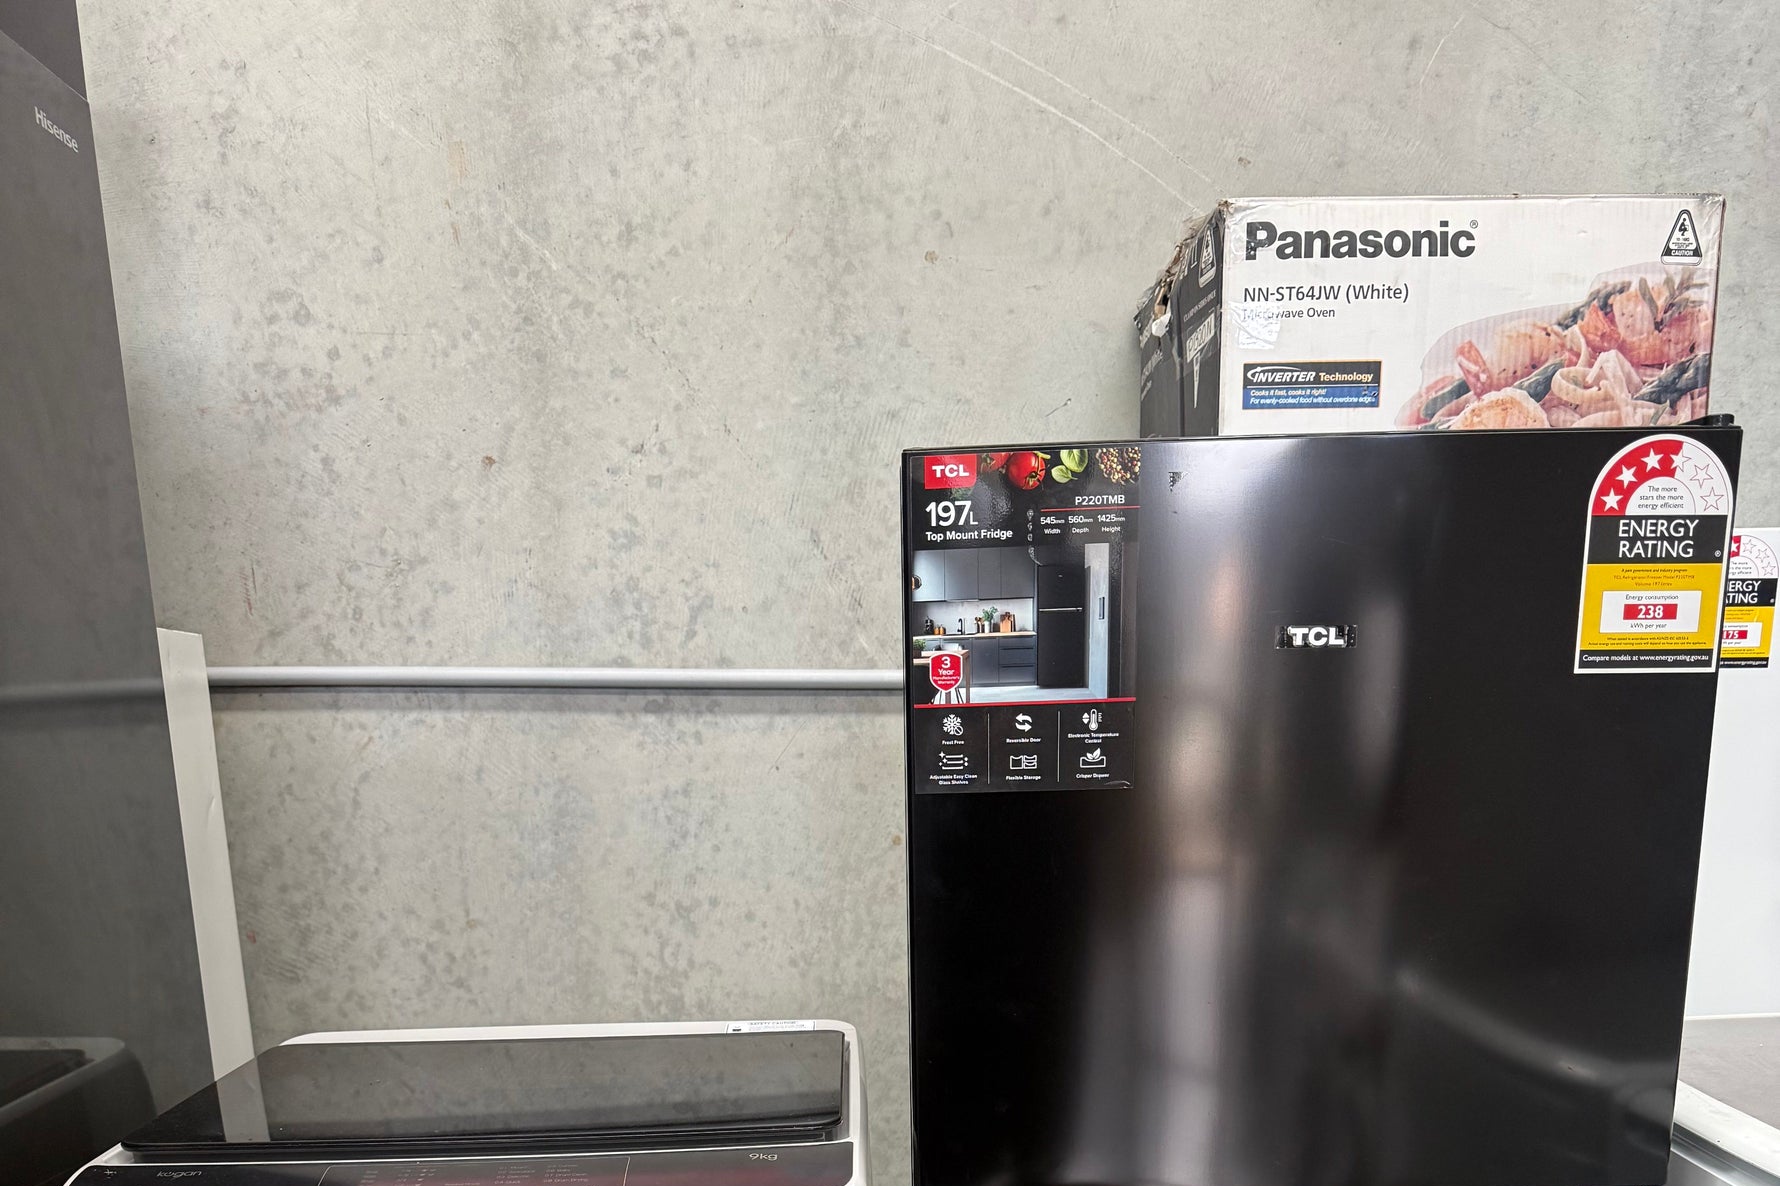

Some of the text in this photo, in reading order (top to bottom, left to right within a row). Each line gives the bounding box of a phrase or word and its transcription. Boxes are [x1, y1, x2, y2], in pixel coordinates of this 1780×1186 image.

[34, 105, 79, 153] Hisense
[1245, 220, 1476, 262] Panasonic
[1243, 283, 1410, 304] NN-ST64JW (White)
[1306, 307, 1336, 319] Oven
[1253, 371, 1374, 383] INVERTER Technology
[931, 464, 970, 478] TCL
[1075, 494, 1126, 506] P220TMB
[925, 500, 979, 527] 197L
[1102, 526, 1121, 534] Height
[1618, 518, 1700, 538] ENERGY
[925, 528, 1014, 543] Top Mount Fridge
[1618, 540, 1694, 558] RATING
[1727, 580, 1762, 592] ERGY
[1726, 593, 1758, 604] TING
[1637, 605, 1664, 618] 238
[1288, 626, 1344, 646] TCL
[941, 656, 951, 668] 3
[1582, 654, 1610, 662] Compare
[1640, 654, 1709, 662] www.energyrating.gov.au
[749, 1152, 778, 1161] 9kg
[156, 1170, 202, 1178] kogan
